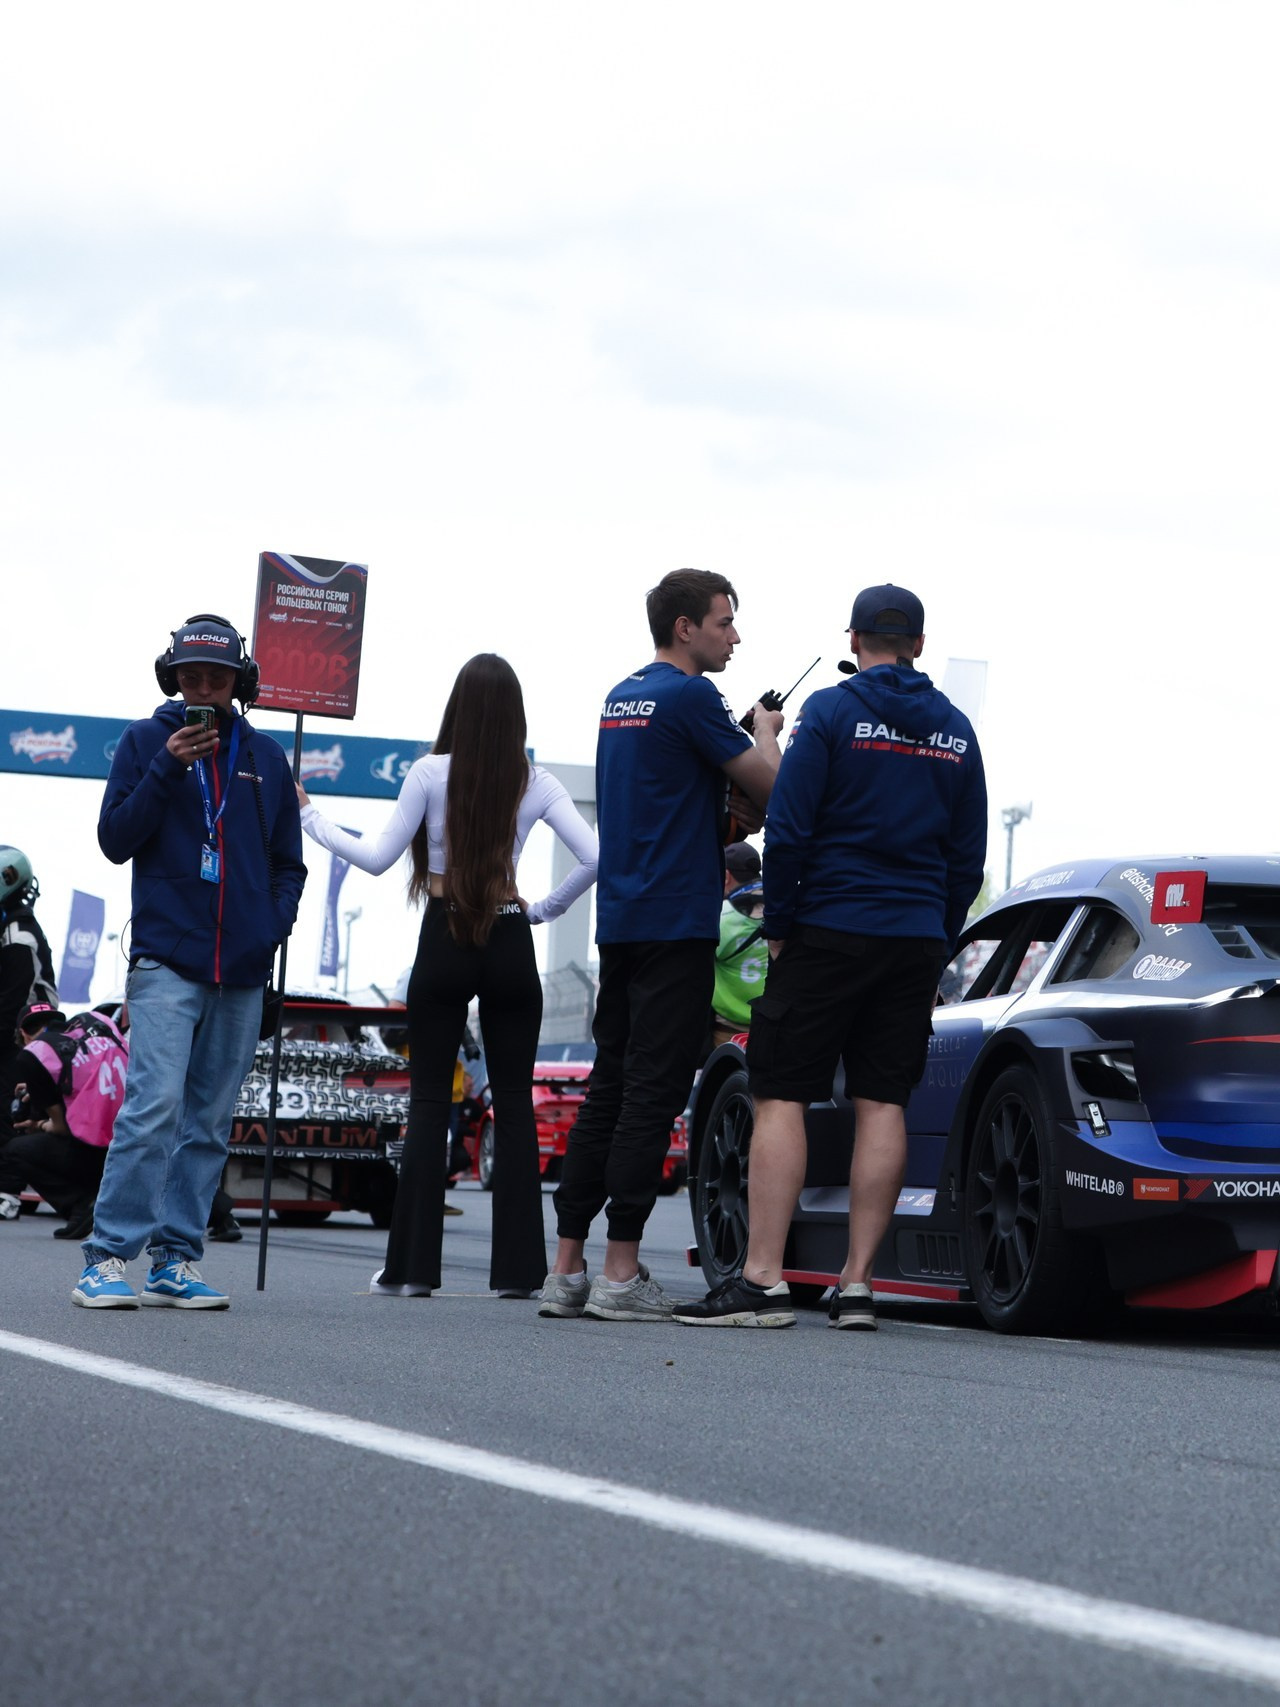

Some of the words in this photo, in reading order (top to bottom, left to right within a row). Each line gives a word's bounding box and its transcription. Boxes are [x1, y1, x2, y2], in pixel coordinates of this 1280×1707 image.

[276, 583, 325, 600] РОССИЙСКАЯ
[325, 589, 350, 602] СЕРИЯ
[275, 595, 322, 611] КОЛЬЦЕВЫХ
[323, 601, 348, 614] ГОНОК
[182, 633, 230, 644] BALCHUG
[265, 646, 349, 690] 2026
[601, 700, 657, 718] ALCHUG
[619, 719, 647, 728] RACING
[918, 747, 961, 764] RACING
[495, 902, 522, 915] CING
[98, 1055, 128, 1100] 41
[229, 1122, 377, 1149] UANTUM
